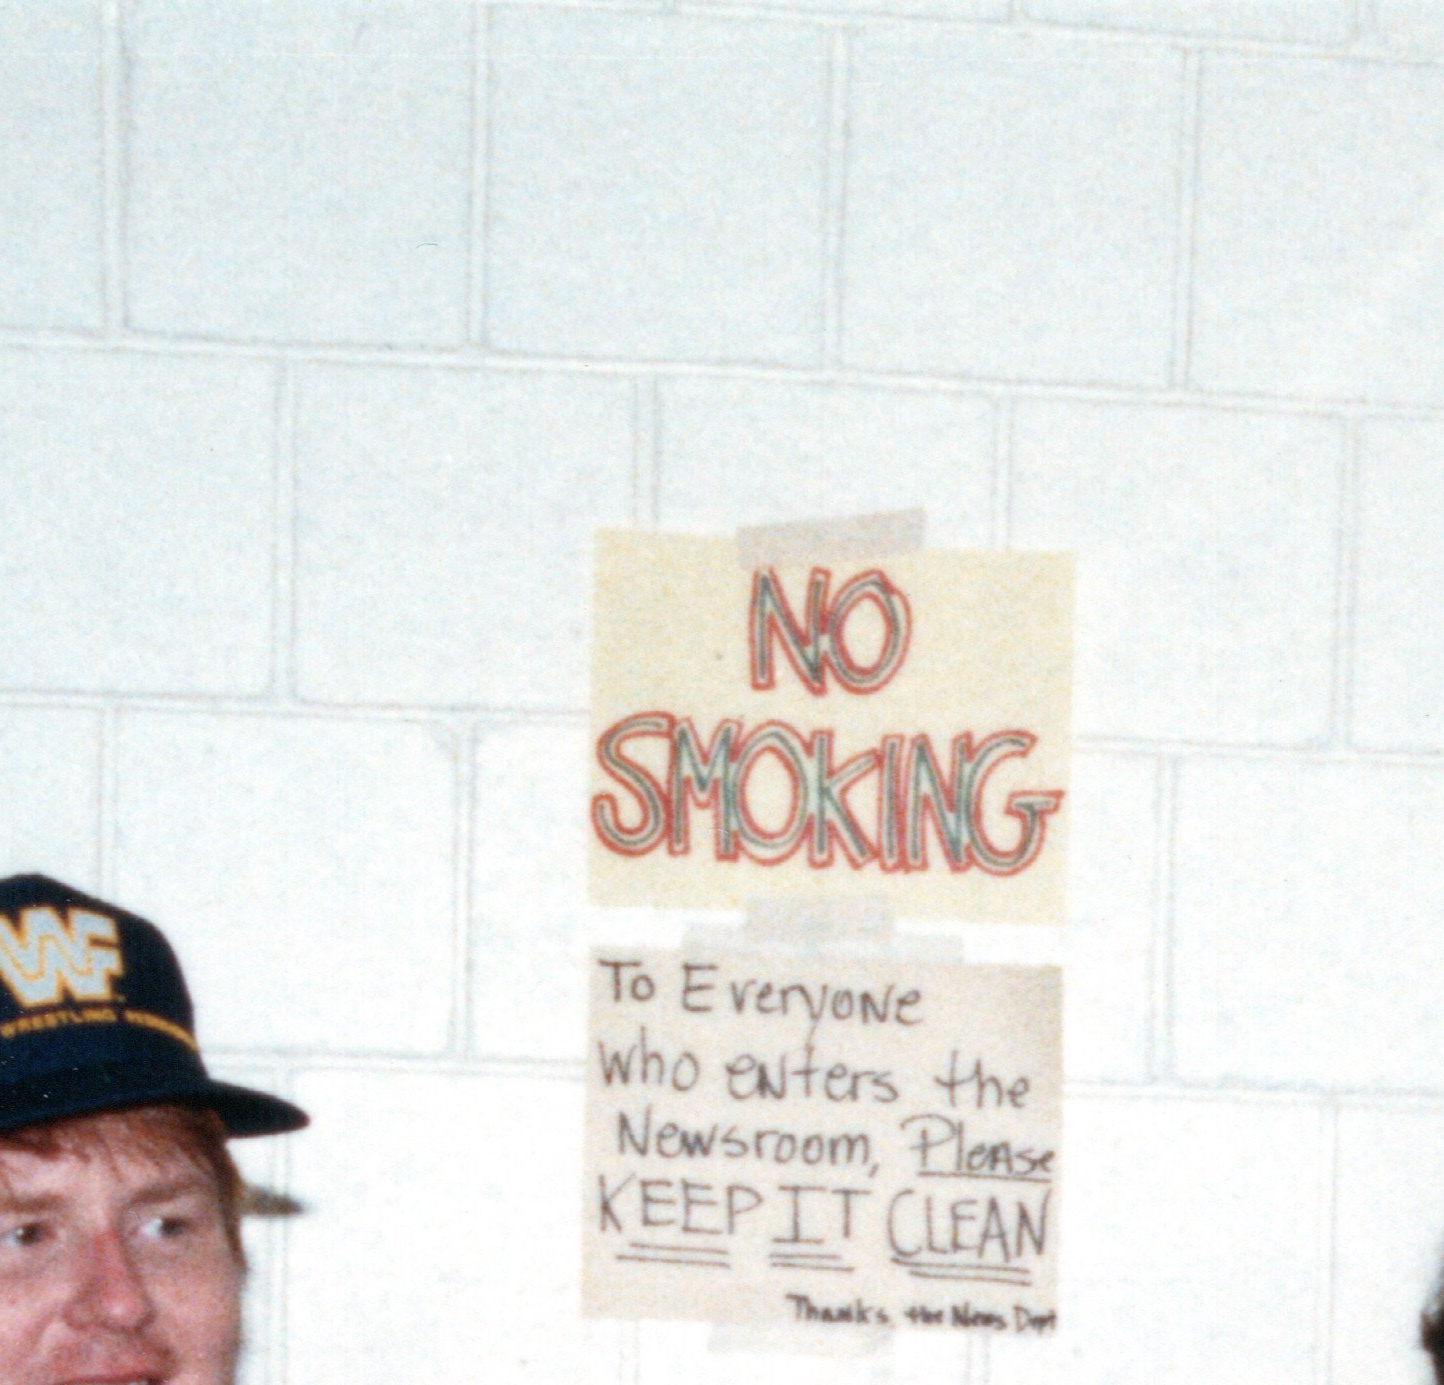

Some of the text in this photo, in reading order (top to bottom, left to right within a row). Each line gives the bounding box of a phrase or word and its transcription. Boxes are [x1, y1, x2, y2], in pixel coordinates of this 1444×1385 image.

[751, 567, 911, 696] NO
[591, 711, 1065, 876] SMOKING
[599, 959, 655, 1001] To
[935, 1050, 1030, 1109] the
[618, 1104, 879, 1177] Newsroom,
[599, 1173, 1052, 1262] KEEP IT CLEAN
